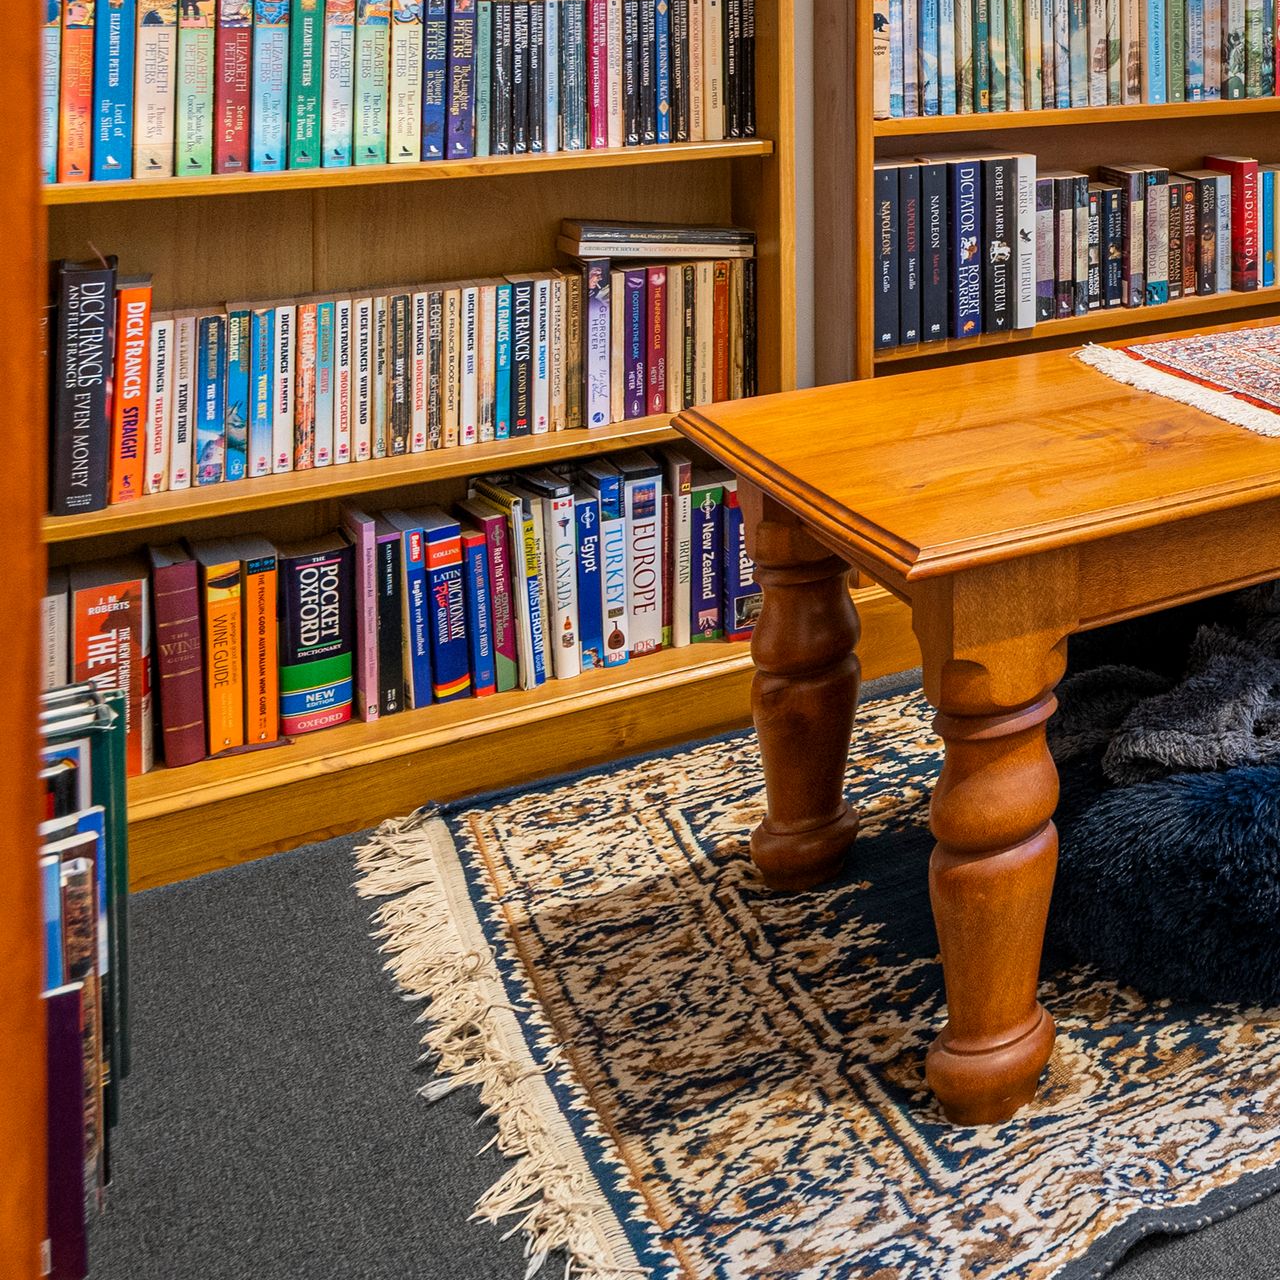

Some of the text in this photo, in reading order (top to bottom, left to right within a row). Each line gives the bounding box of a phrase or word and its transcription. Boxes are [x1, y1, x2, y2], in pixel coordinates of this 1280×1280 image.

[109, 13, 120, 87] ELIZABETH PETERS
[224, 42, 236, 83] PETERS
[235, 32, 248, 92] ELIZABETH
[100, 100, 111, 141] the Silent
[114, 104, 125, 137] Lord of
[225, 106, 234, 127] Large
[225, 129, 233, 142] Cat
[235, 105, 245, 130] Seeing
[960, 168, 974, 233] DICTATOR
[1245, 173, 1253, 265] VINDOLANDA
[881, 201, 891, 255] NAPOLEON
[993, 166, 1005, 311] ROBERT HARRIS LUSTRUM
[1148, 189, 1157, 276] CATILINA'S RIDDLE
[958, 267, 968, 317] HARRIS
[969, 264, 979, 314] ROBERT
[66, 285, 78, 388] AND FELIX FRANCIS
[78, 282, 105, 387] DICK FRANCIS
[121, 302, 145, 459] DICK FRANCIS STRAIGHT
[71, 393, 91, 487] EVEN MONEY
[257, 574, 265, 585] THE
[433, 569, 461, 583] LATIN
[555, 543, 574, 611] CANADA
[581, 536, 598, 573] Egypt
[605, 524, 624, 605] TURKEY
[633, 522, 656, 616] EUROPE
[679, 540, 690, 584] BRITAIN
[702, 523, 715, 599] New Zealand
[88, 601, 130, 615] ROBERTS
[299, 568, 320, 646] OXFORD
[320, 565, 339, 635] POCKET
[413, 580, 423, 606] English
[415, 608, 423, 623] verb
[433, 583, 448, 644] Plus GRAMMAR
[447, 578, 465, 639] DICTIONARY
[529, 580, 543, 654] AMSTERDAM
[87, 629, 116, 669] THE
[212, 615, 227, 648] WINE
[297, 644, 342, 657] DICTIONARY
[416, 624, 425, 656] handbook
[118, 628, 130, 691] THE NEW PENGUIN
[214, 650, 229, 688] GUIDE
[306, 688, 335, 702] NEW
[297, 713, 343, 729] OXFORD
